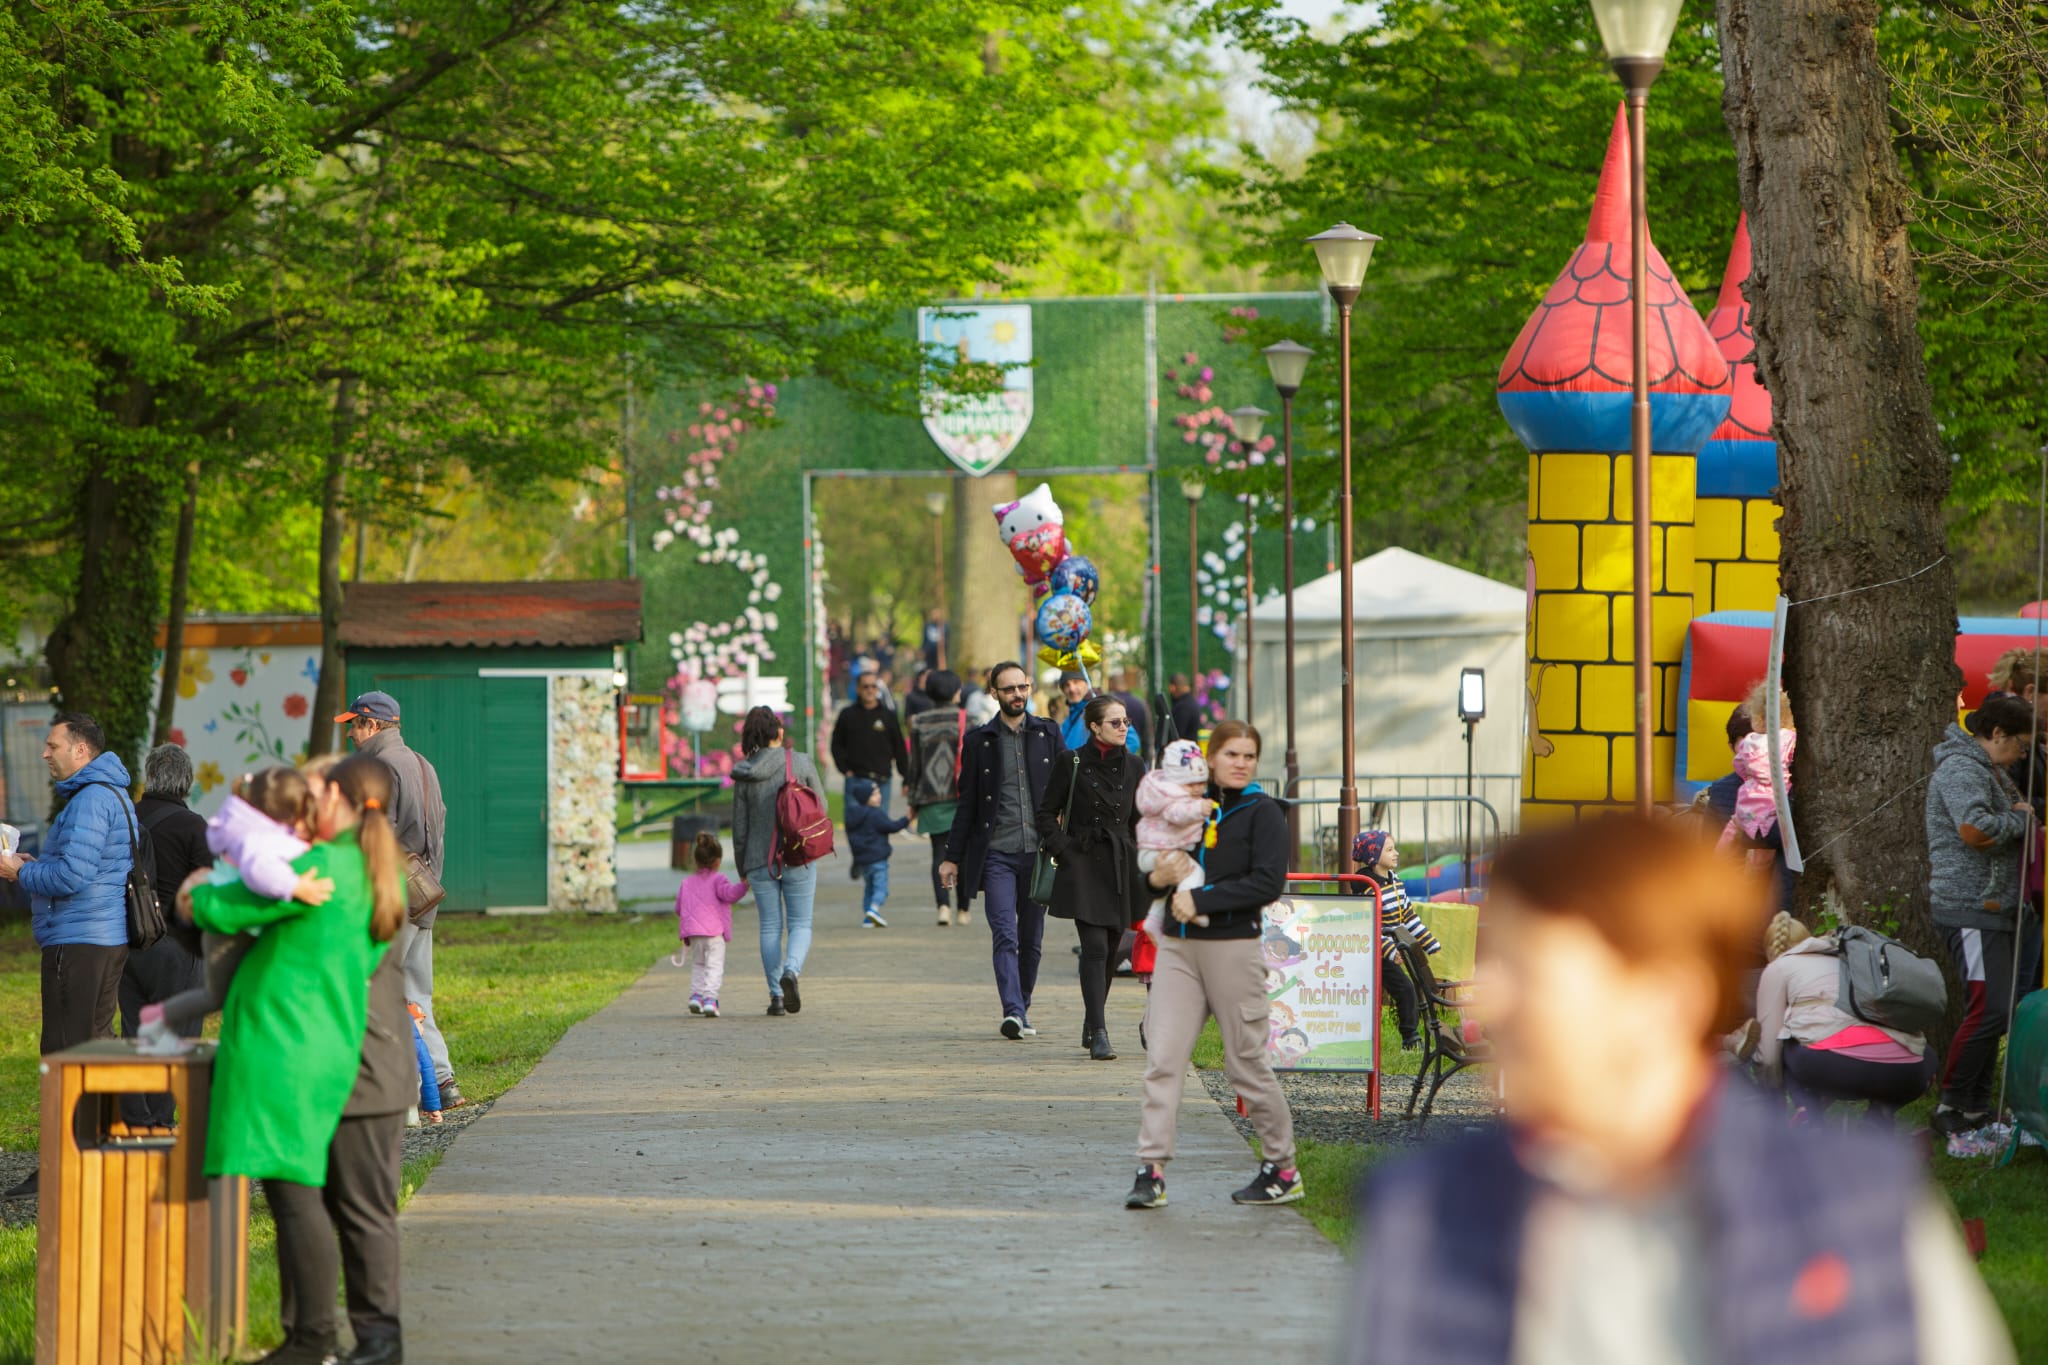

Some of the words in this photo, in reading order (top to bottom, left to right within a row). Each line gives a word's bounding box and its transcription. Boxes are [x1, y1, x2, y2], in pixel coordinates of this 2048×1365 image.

[1296, 926, 1370, 961] Topogane
[1314, 960, 1345, 978] de
[1296, 979, 1369, 1005] închiriat
